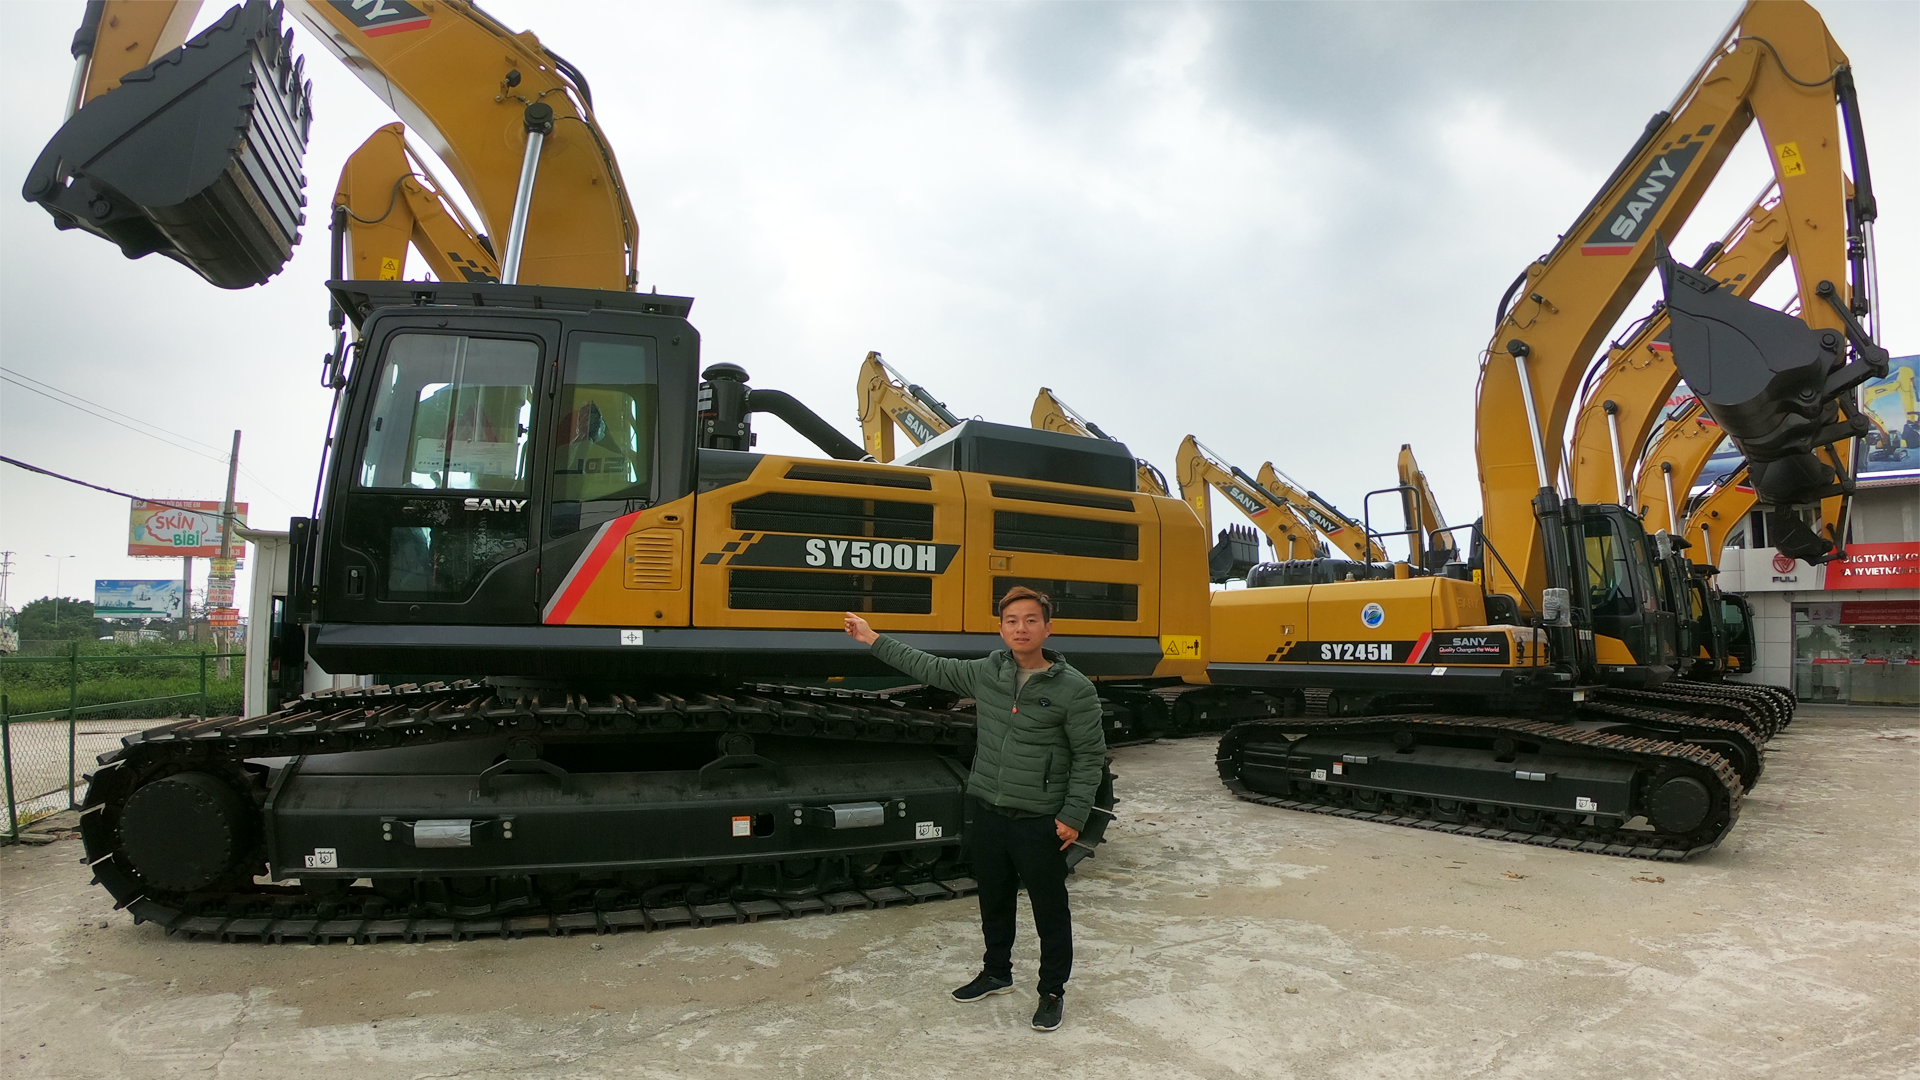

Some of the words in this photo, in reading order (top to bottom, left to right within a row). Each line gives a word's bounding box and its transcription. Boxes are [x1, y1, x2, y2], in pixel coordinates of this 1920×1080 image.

[1610, 157, 1676, 240] SANY
[904, 413, 934, 443] SANY
[463, 497, 529, 513] SANY
[1230, 488, 1259, 512] SANY
[1308, 510, 1335, 531] SANY
[805, 537, 938, 573] SY500H
[1864, 554, 1876, 562] TY
[1320, 642, 1392, 661] SY245H
[1453, 637, 1488, 646] SANY
